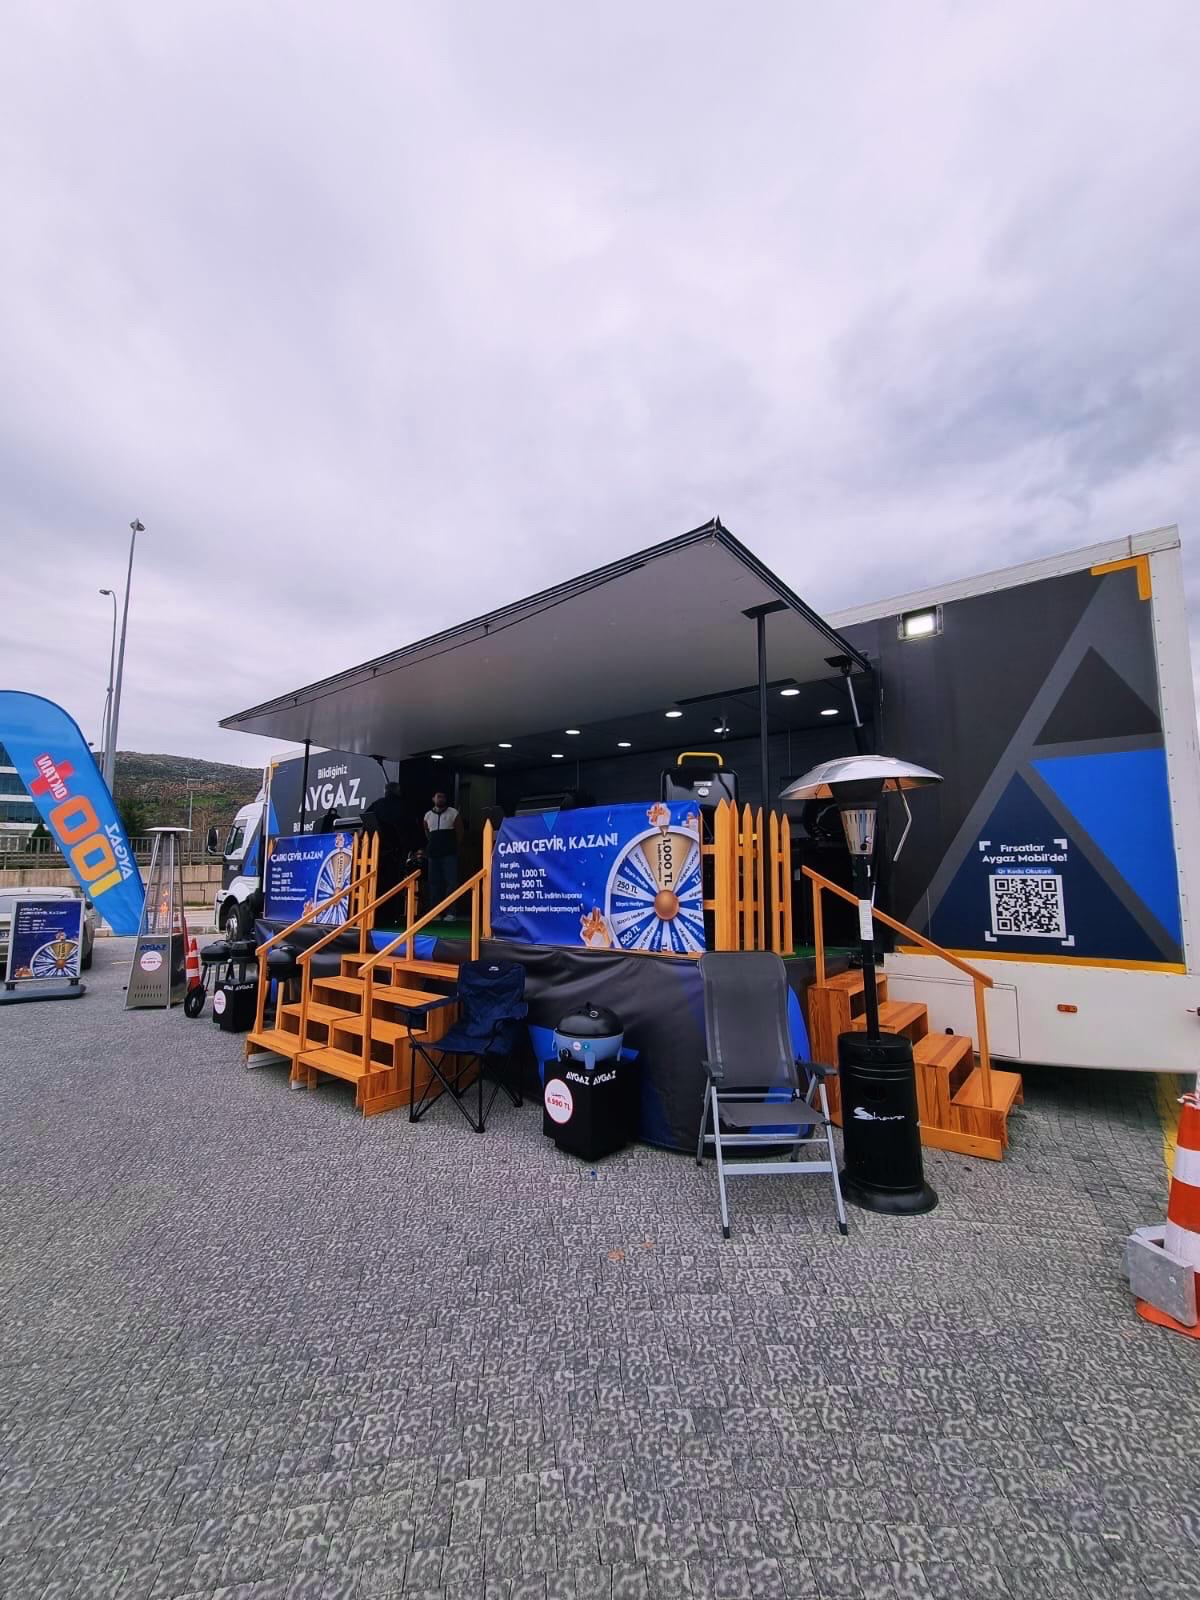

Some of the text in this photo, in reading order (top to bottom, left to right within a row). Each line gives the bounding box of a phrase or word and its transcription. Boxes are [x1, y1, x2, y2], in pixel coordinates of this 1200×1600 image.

[498, 832, 618, 857] ÇARKI ÇEVİR, KAZAN!
[1000, 844, 1045, 852] Fırsatlar
[982, 853, 1067, 864] Aygaz Mobil'de!
[538, 868, 547, 877] TL
[521, 880, 535, 888] 500
[536, 879, 544, 888] TL
[664, 872, 672, 887] TL
[617, 880, 629, 891] 250
[631, 884, 639, 895] TL
[522, 890, 535, 900] 250
[536, 890, 543, 899] TL
[620, 930, 633, 945] 500
[566, 1070, 617, 1086] AYGAZ AYGAZ
